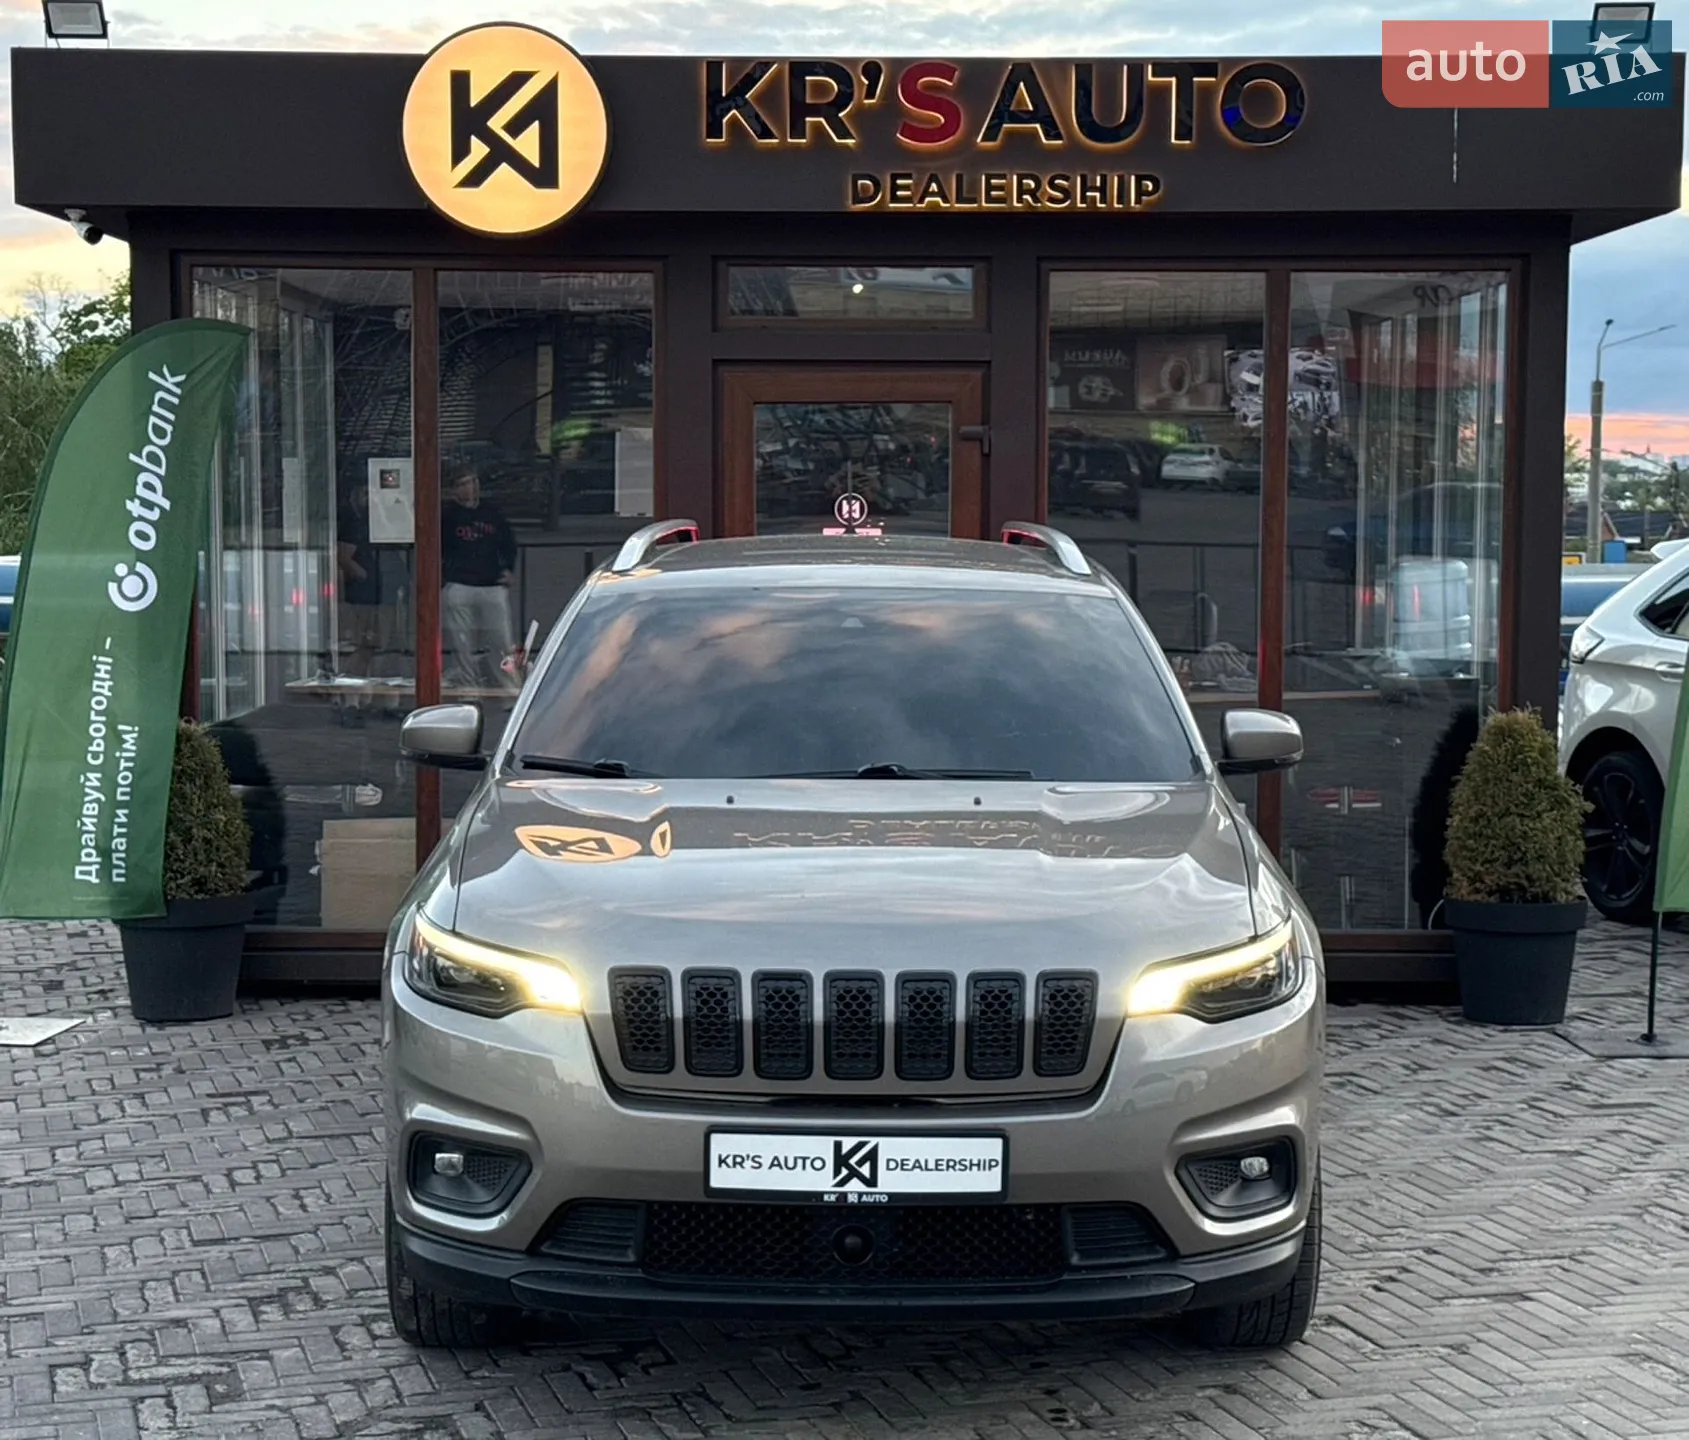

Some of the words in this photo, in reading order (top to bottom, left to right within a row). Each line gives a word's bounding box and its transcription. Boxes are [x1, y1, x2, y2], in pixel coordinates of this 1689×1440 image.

[705, 60, 963, 146] KR'S
[978, 62, 1307, 146] AUTO
[850, 173, 1163, 209] DEALERSHIP
[125, 364, 187, 552] otpbank
[88, 655, 115, 767] сьогодні
[115, 724, 141, 800] потім!
[74, 770, 103, 885] Драйвуй
[111, 803, 129, 884] плати
[717, 1153, 763, 1170] KR'S
[768, 1155, 826, 1172] AUTO
[886, 1158, 1000, 1173] DEALERSHIP
[861, 1194, 889, 1204] AUTO
